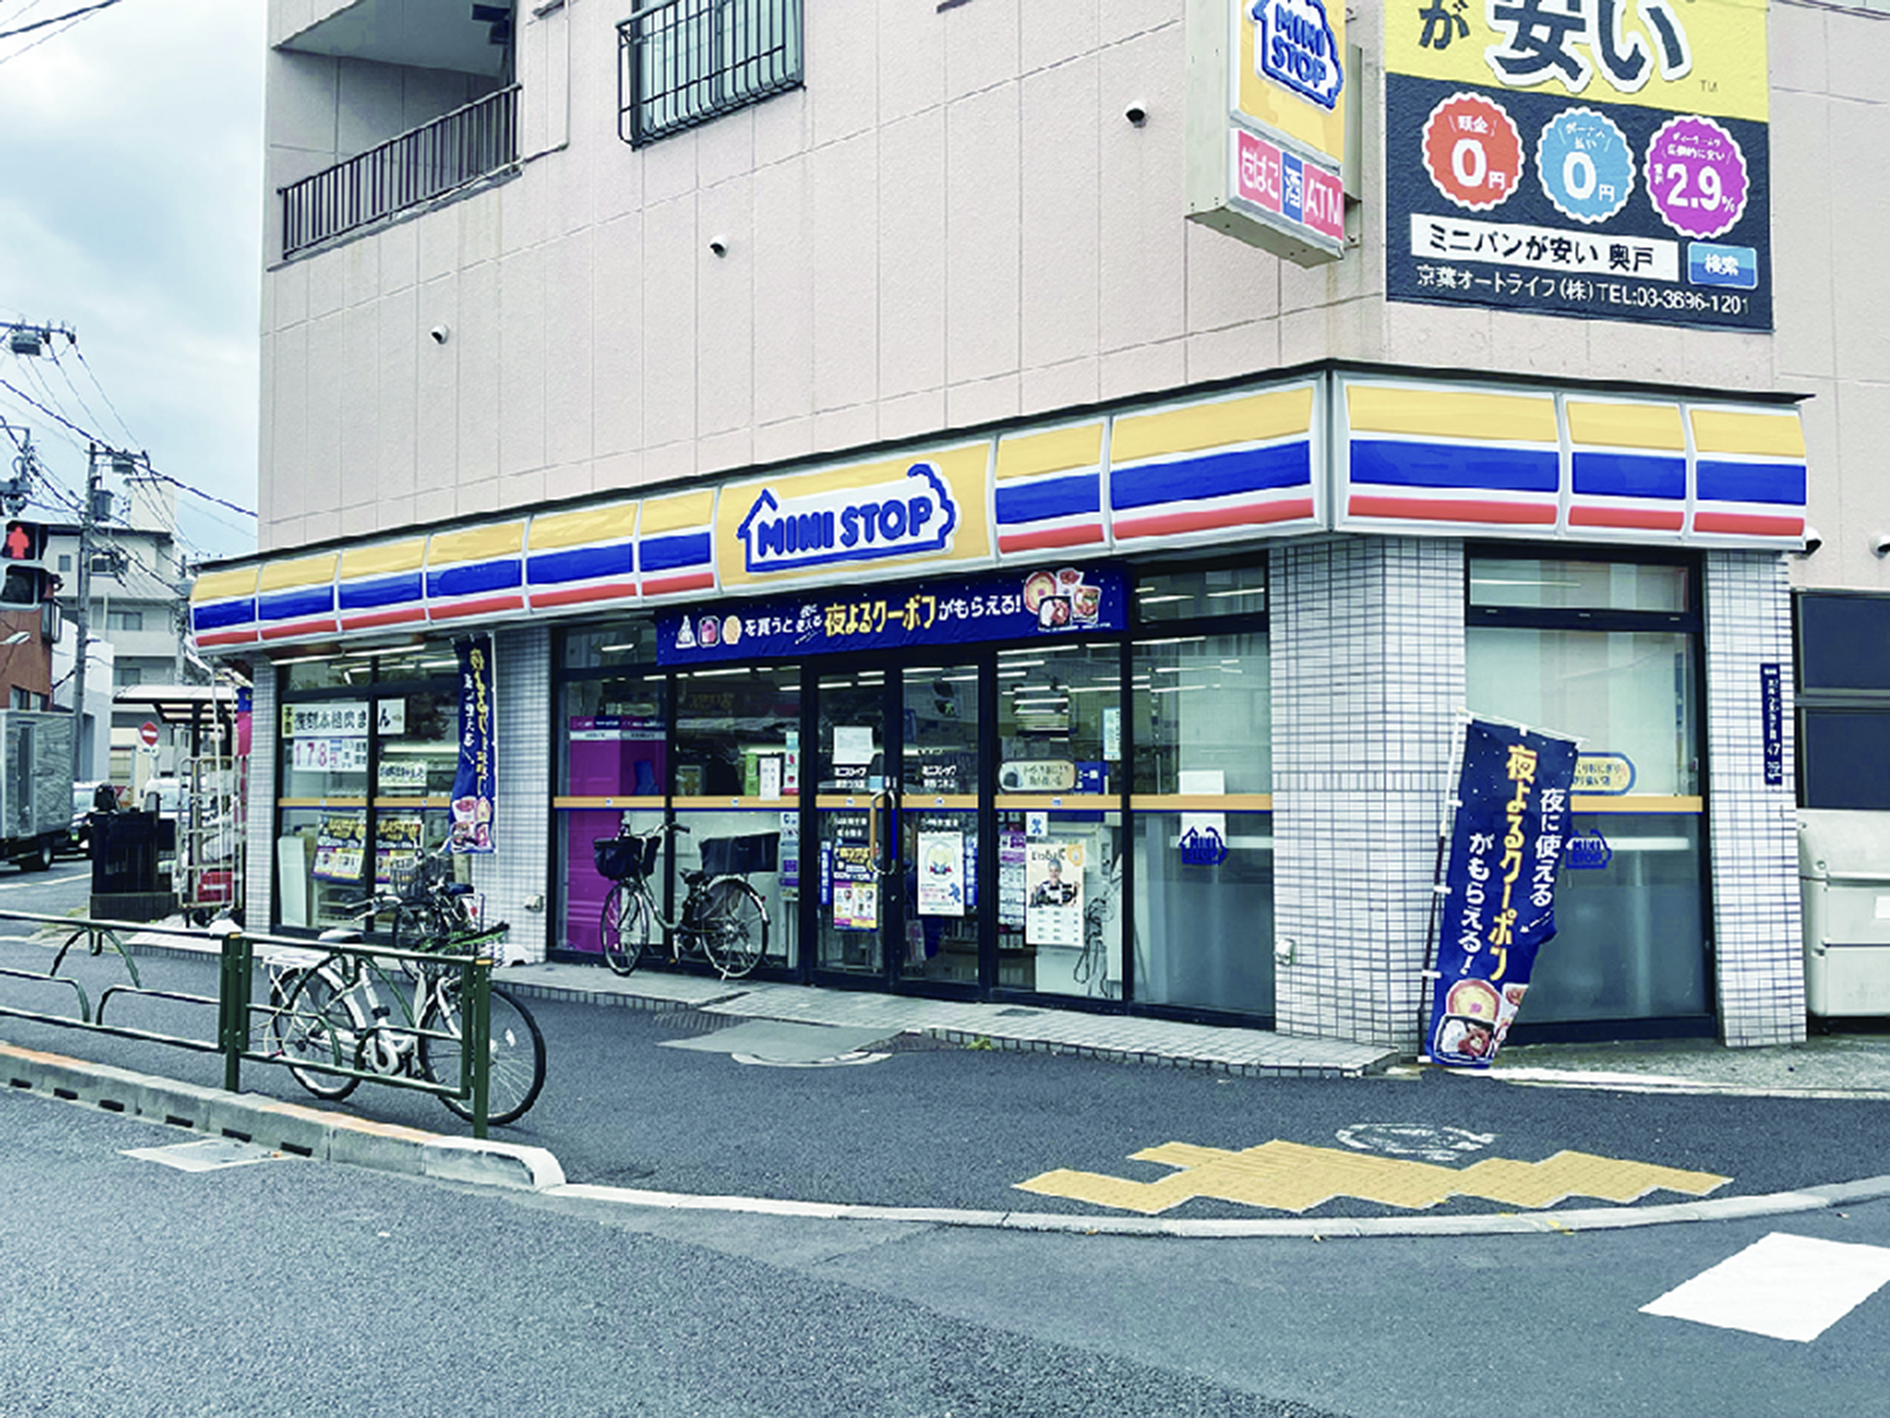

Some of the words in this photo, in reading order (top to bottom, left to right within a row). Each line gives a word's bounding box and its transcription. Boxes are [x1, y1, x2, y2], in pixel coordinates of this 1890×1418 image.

[1275, 2, 1325, 57] MINI
[1271, 34, 1326, 88] STOP
[1241, 146, 1280, 201] たばこ
[1284, 164, 1302, 209] 酒
[1452, 138, 1506, 191] 0円
[1563, 151, 1615, 203] 0円
[1667, 163, 1736, 213] 2.9%
[1305, 178, 1342, 228] ATM
[1430, 223, 1599, 264] ミニバンが安い
[1608, 243, 1654, 272] 奥戸
[758, 510, 835, 558] MINI
[840, 496, 933, 548] STOP
[1529, 788, 1567, 909] 夜に使える
[1457, 833, 1496, 976] がもらえる!
